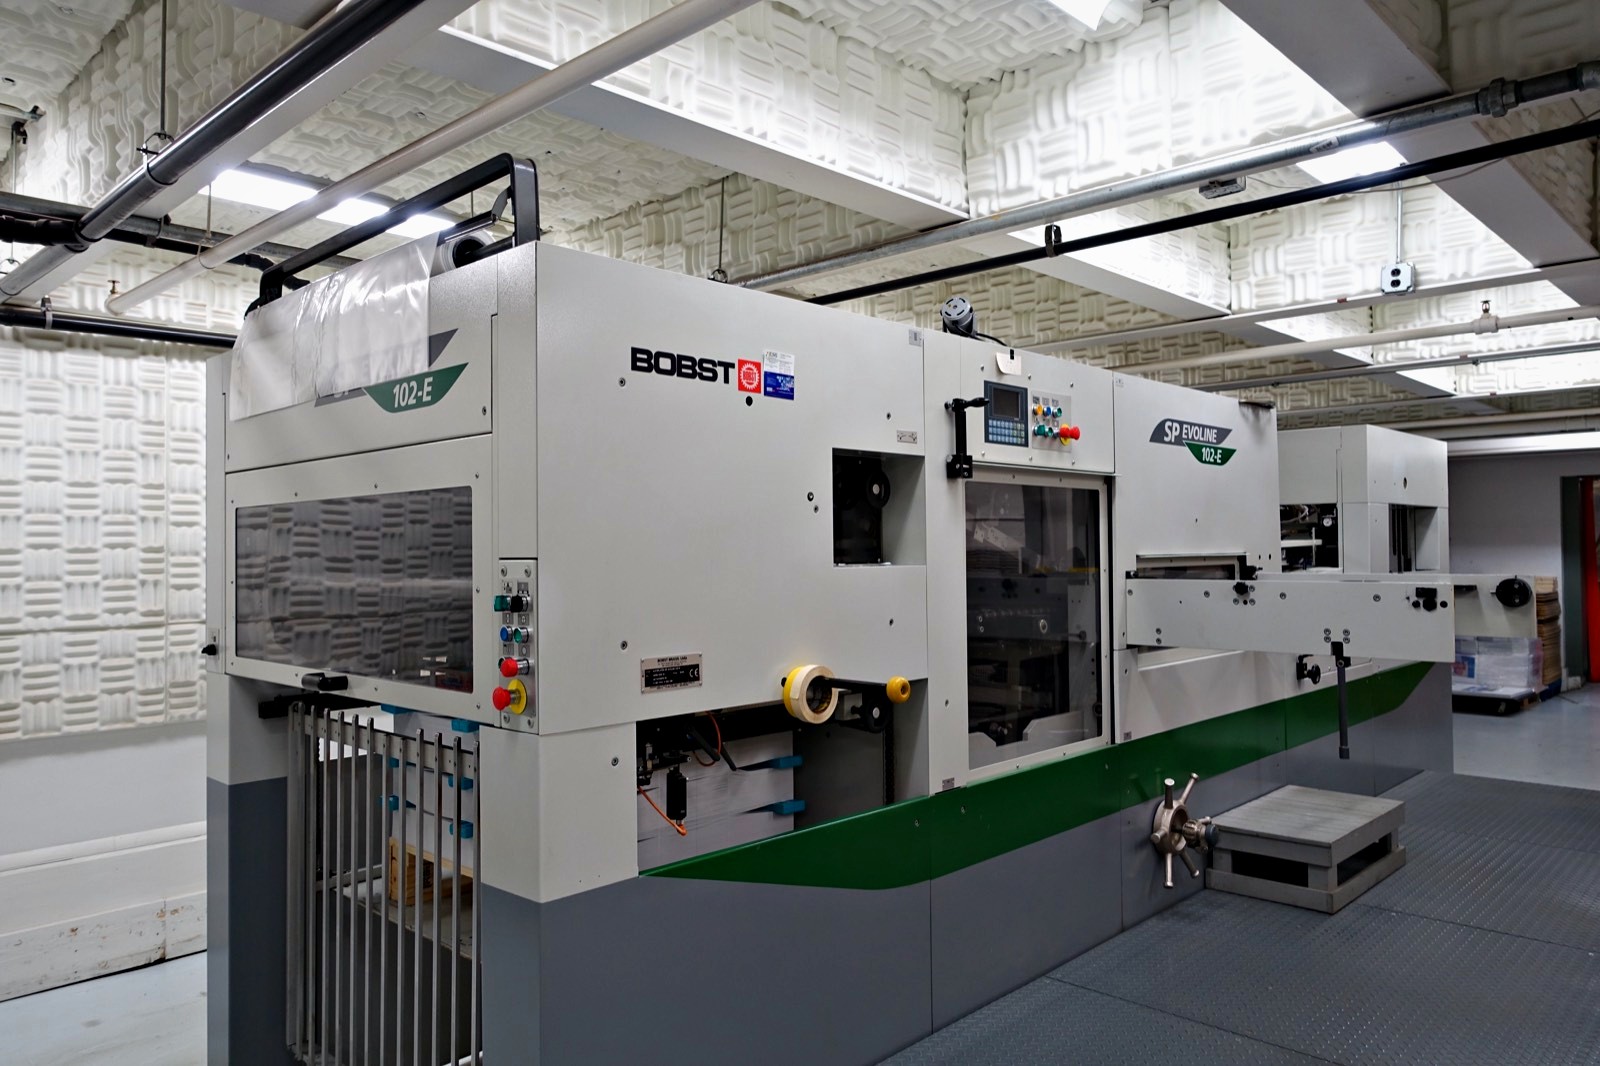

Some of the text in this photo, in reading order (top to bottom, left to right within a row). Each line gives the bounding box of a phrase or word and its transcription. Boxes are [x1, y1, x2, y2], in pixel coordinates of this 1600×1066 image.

[631, 347, 735, 384] BOBST
[393, 377, 433, 409] 102-E
[1164, 421, 1218, 443] SP EVOLINE
[1202, 447, 1222, 463] 102-E
